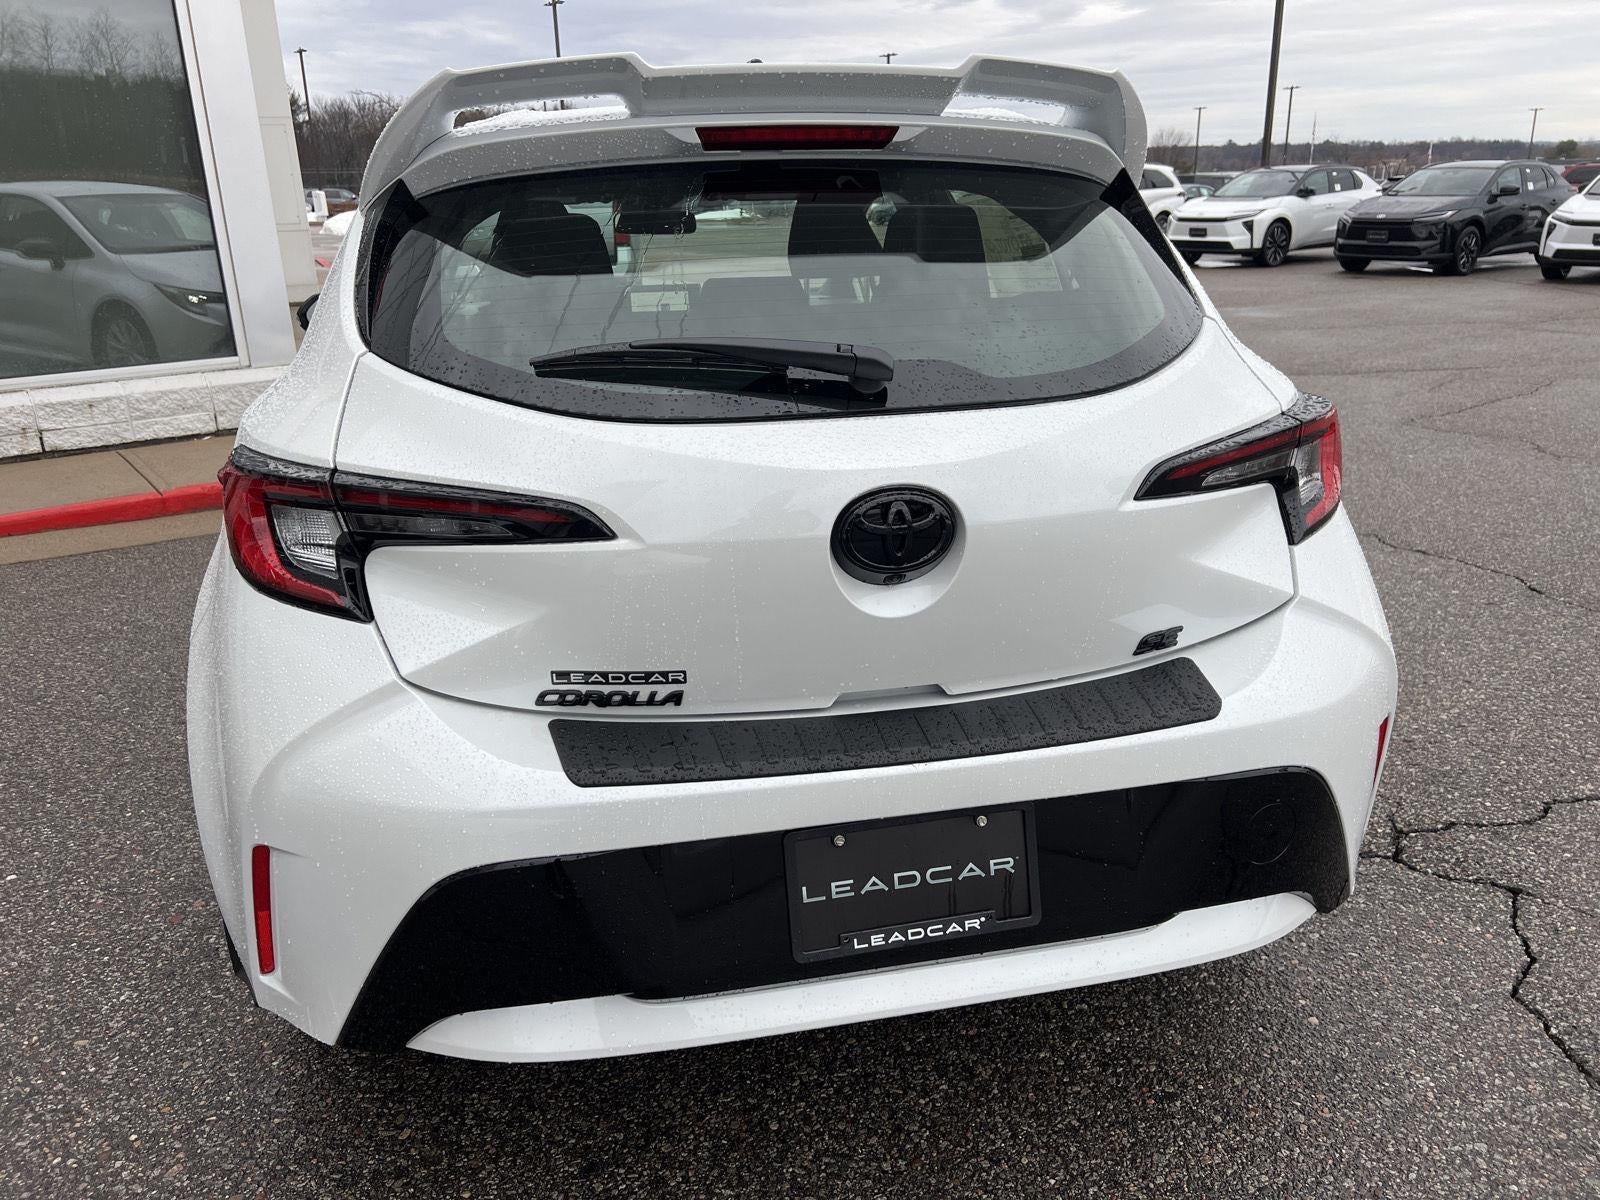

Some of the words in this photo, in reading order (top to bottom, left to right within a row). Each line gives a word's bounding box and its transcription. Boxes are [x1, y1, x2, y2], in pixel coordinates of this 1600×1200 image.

[552, 672, 685, 683] LEADCAR
[535, 689, 684, 708] COROLLA
[802, 857, 1015, 903] LEADCAR
[854, 919, 980, 949] LEADCAR
